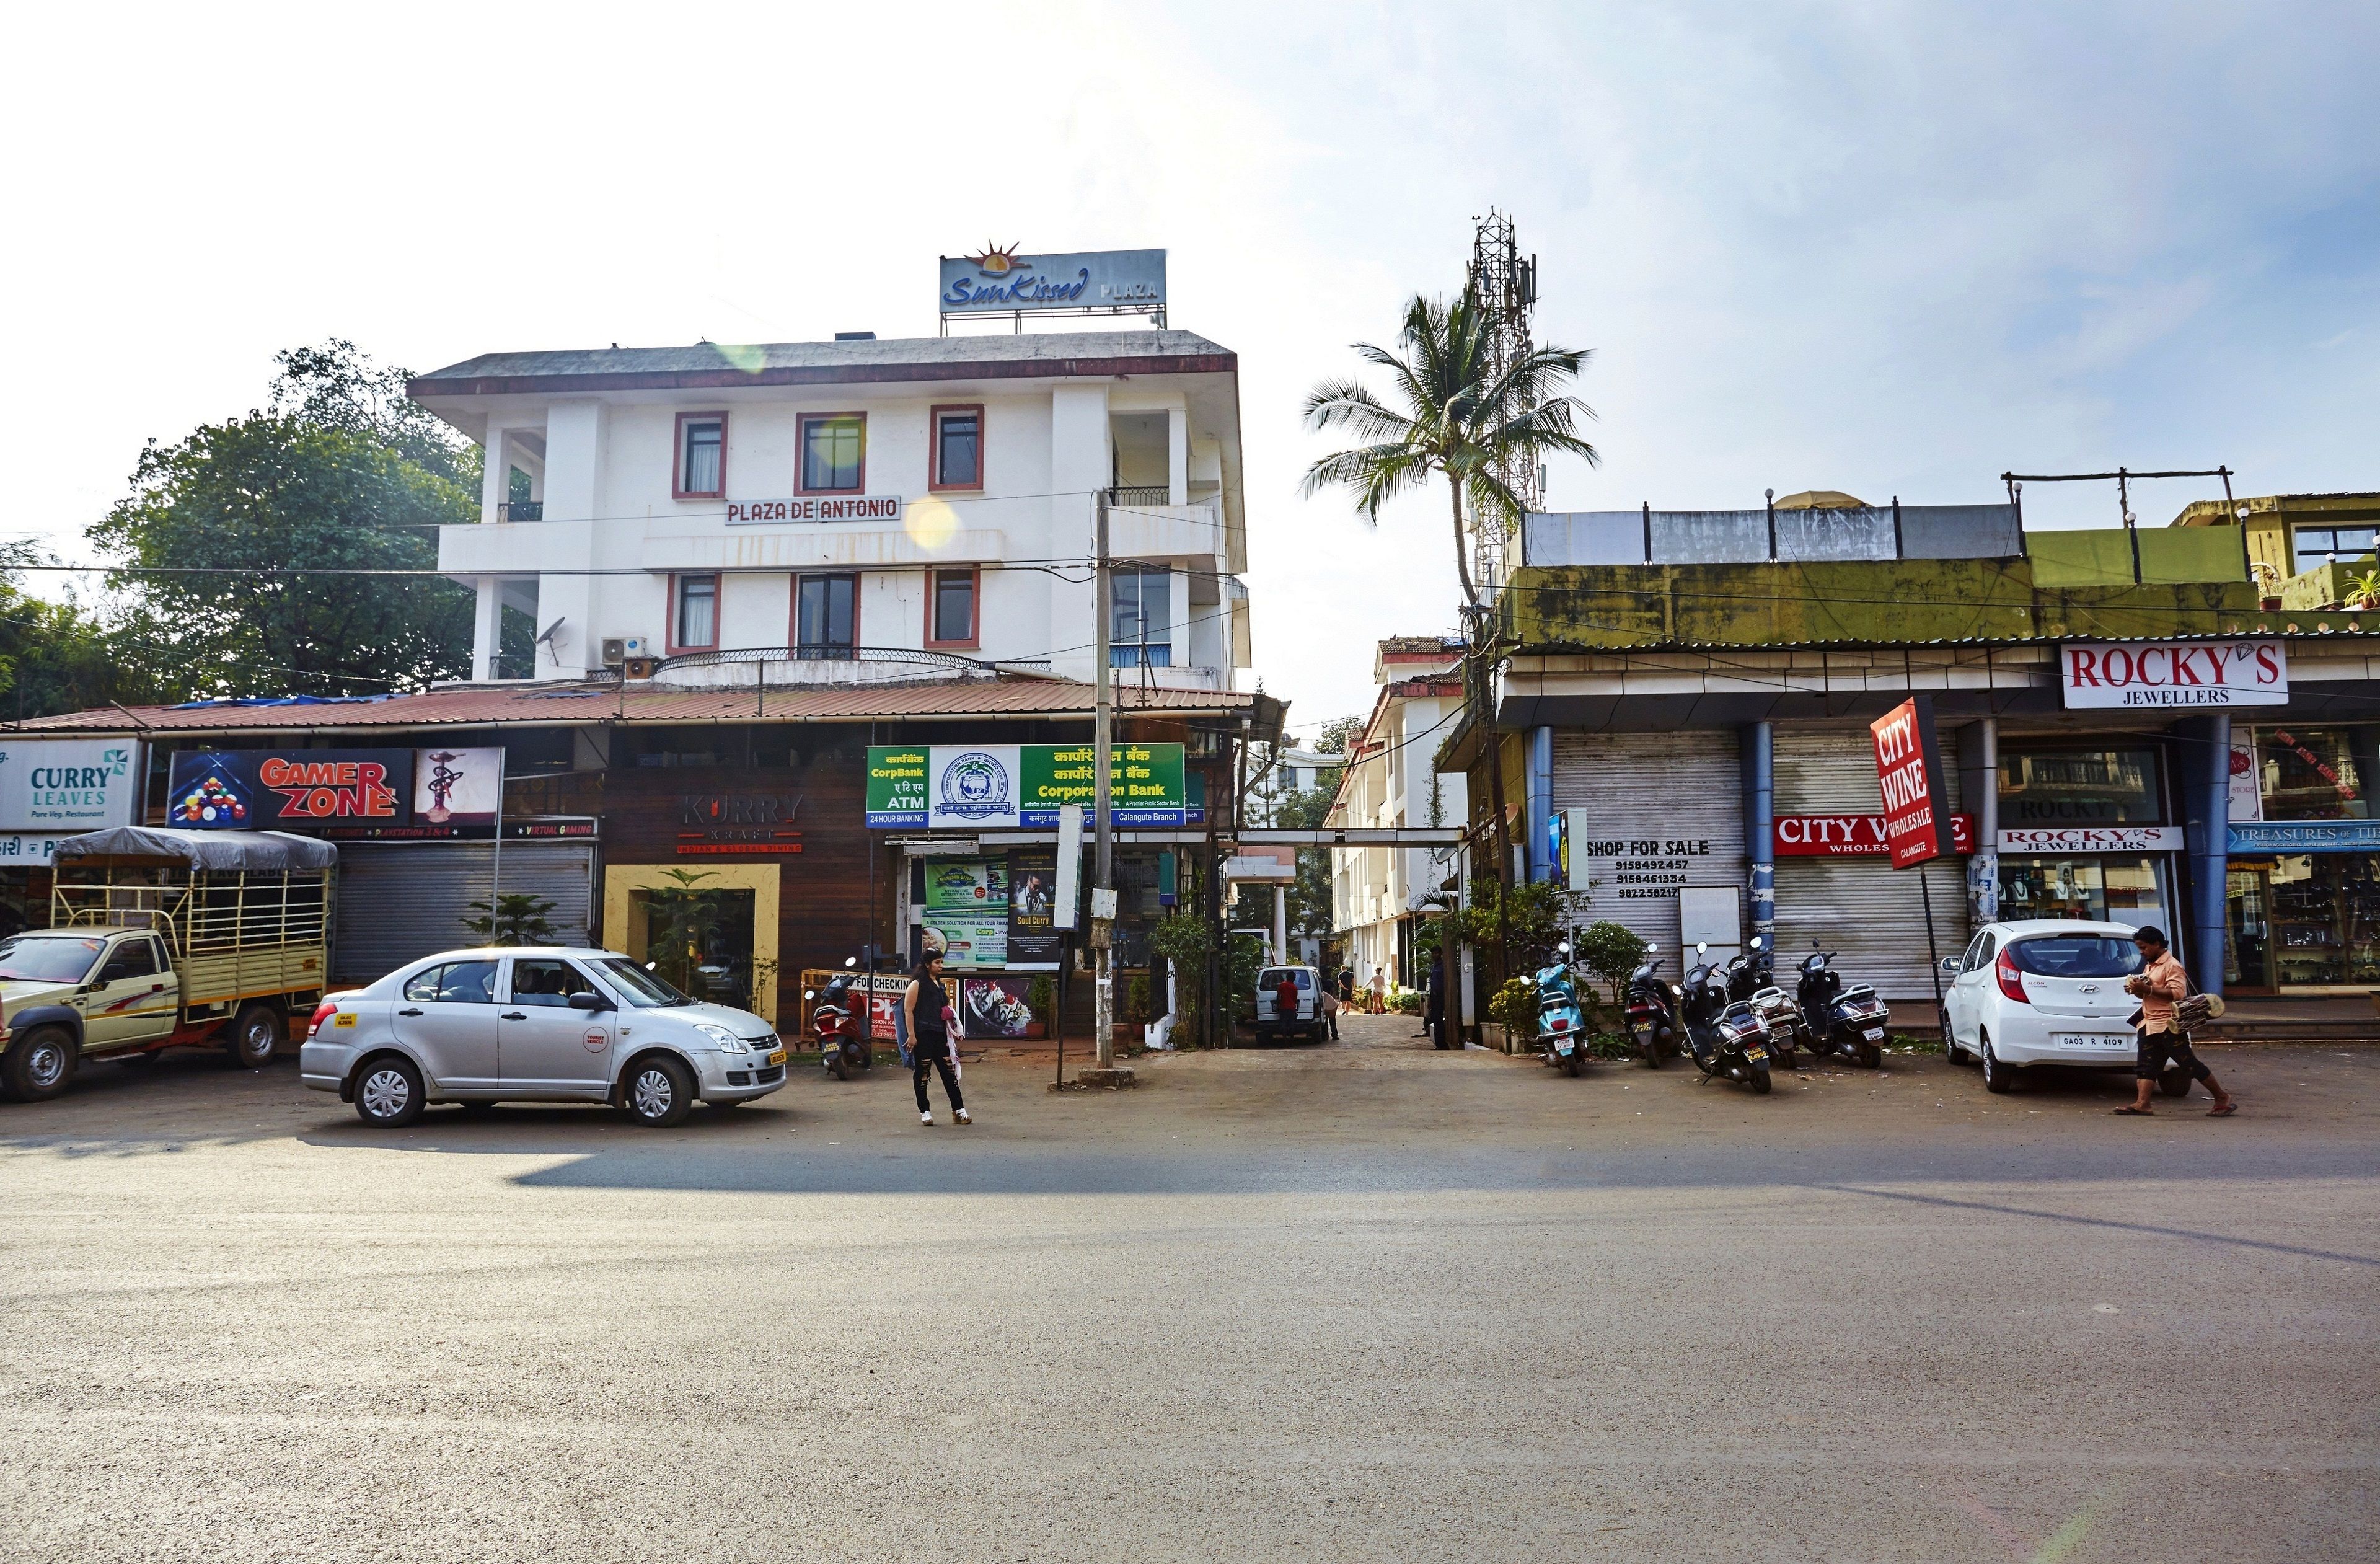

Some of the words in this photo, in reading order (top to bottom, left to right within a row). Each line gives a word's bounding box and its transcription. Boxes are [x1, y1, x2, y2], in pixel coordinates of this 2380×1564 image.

[943, 268, 1088, 304] SunKissed
[1100, 281, 1157, 299] PLAZA
[728, 503, 786, 521] PLAZA
[791, 501, 813, 519] DE
[821, 499, 896, 518] ANTONIO
[2123, 690, 2229, 705] JEWELLERS
[1878, 713, 1913, 766] CITY
[31, 767, 110, 789] CURRY
[871, 768, 923, 779] CorpBank
[945, 762, 961, 794] CORPORATION
[260, 758, 399, 805] GAMER
[1881, 758, 1927, 813] WINE
[33, 792, 105, 805] LEAVES
[1038, 785, 1124, 799] Corporaon
[1129, 784, 1165, 796] Bank
[269, 788, 395, 817] ZONE
[683, 794, 803, 823] KURRY
[887, 797, 923, 808] ATM
[49, 811, 63, 819] Veg.
[1119, 813, 1152, 823] Calangute
[1154, 813, 1176, 821] Branch
[527, 826, 557, 834] VIRTUAL
[560, 826, 591, 834] GAMING
[1779, 818, 1858, 843] CITY
[1889, 807, 1931, 839] WHOLESALE
[375, 829, 423, 837] PLAYSTATION
[710, 829, 774, 839] KRAFT
[2237, 828, 2335, 841] TREASURES
[2340, 830, 2350, 838] OF
[1587, 842, 1624, 856] SHOP
[1631, 841, 1659, 855] FOR
[1665, 840, 1709, 855] SALE
[1901, 842, 1926, 859] CALANGUTE
[2024, 841, 2146, 851] JEWELLERS
[1616, 860, 1688, 870] 9158492457
[1616, 875, 1686, 884] 9158461334
[1032, 917, 1049, 925] Curry
[874, 978, 910, 990] CHECKIN
